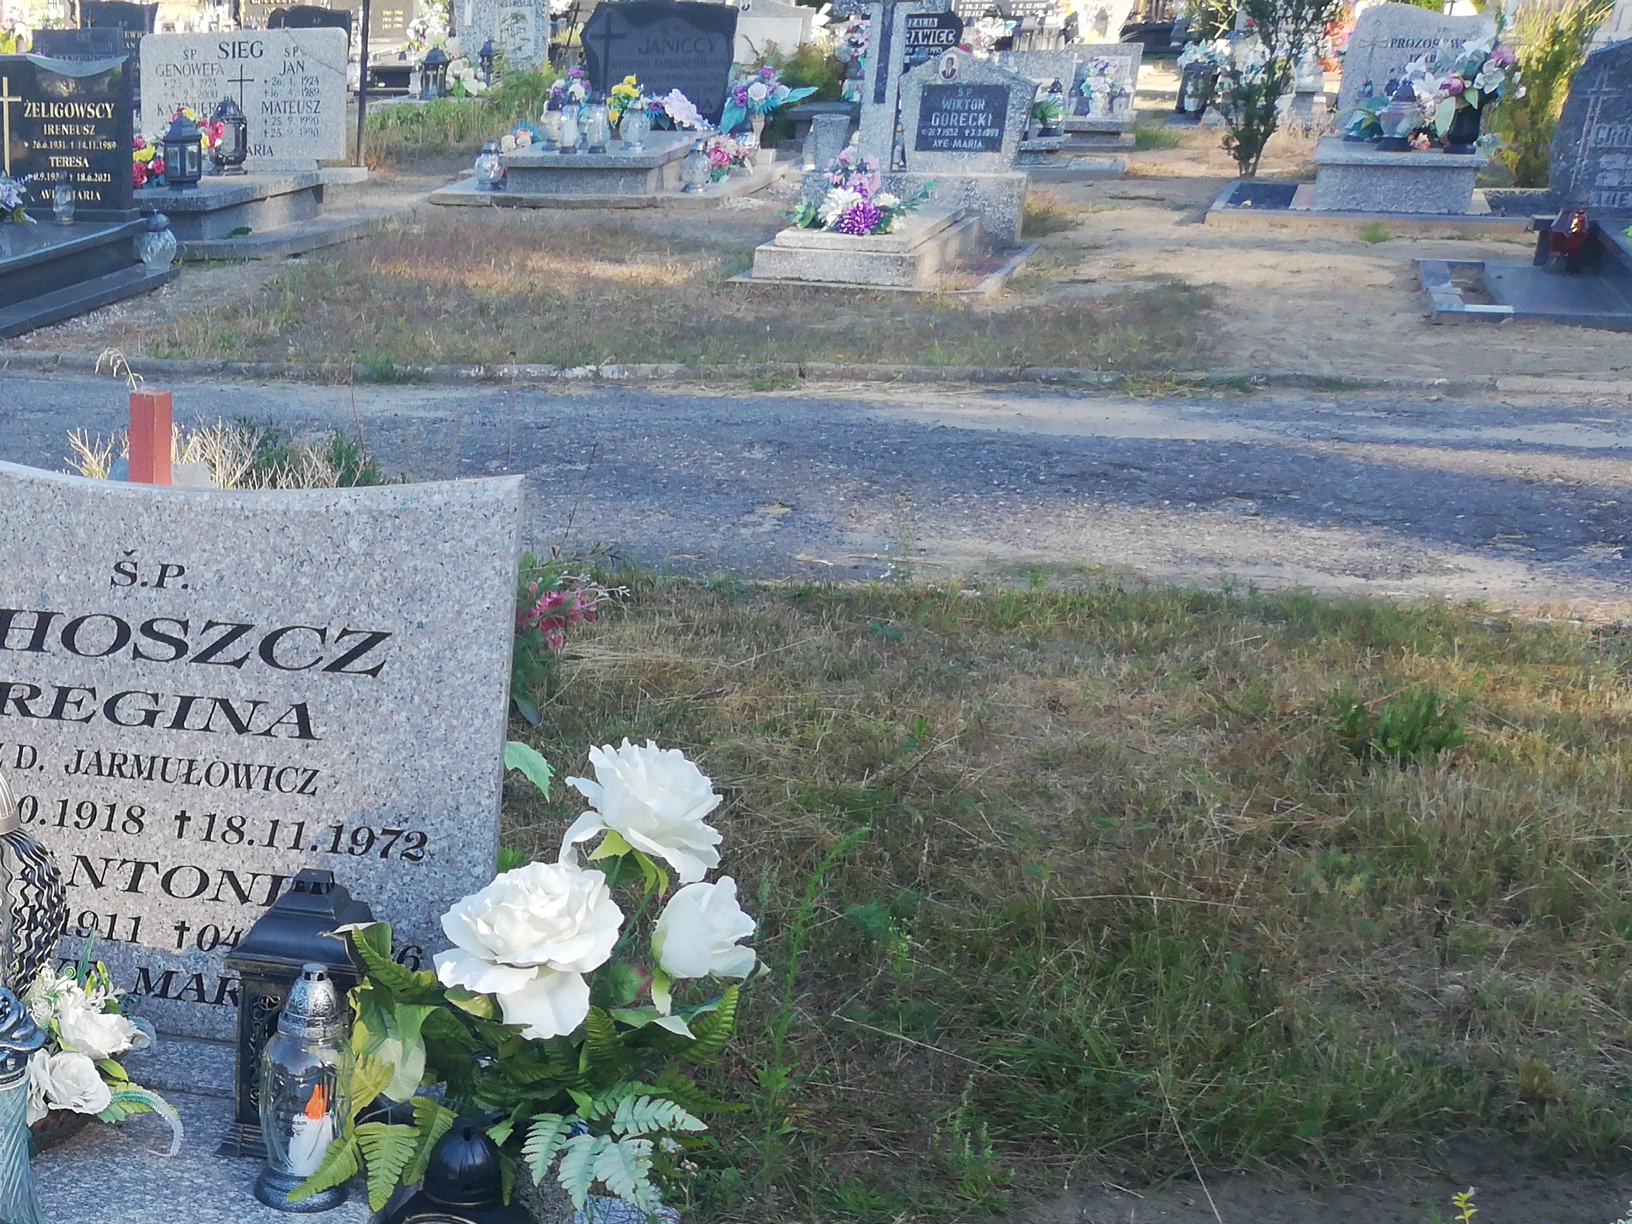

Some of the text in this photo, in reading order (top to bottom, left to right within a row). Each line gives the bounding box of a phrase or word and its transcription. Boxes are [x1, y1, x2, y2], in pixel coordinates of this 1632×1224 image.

[217, 40, 264, 59] SIEG
[638, 37, 719, 55] JANICCY
[155, 60, 305, 77] GENOWEFA JAN
[23, 99, 115, 119] ŻELIGOWSCY
[261, 100, 321, 115] MATEUSZ
[941, 98, 985, 110] WIKTOR
[43, 123, 96, 136] IRENEUSZ
[932, 139, 983, 148] AVE MARIA
[48, 156, 90, 168] TERESA
[65, 748, 320, 797] JARMUŁOWICZ
[132, 966, 242, 1008] MAR
